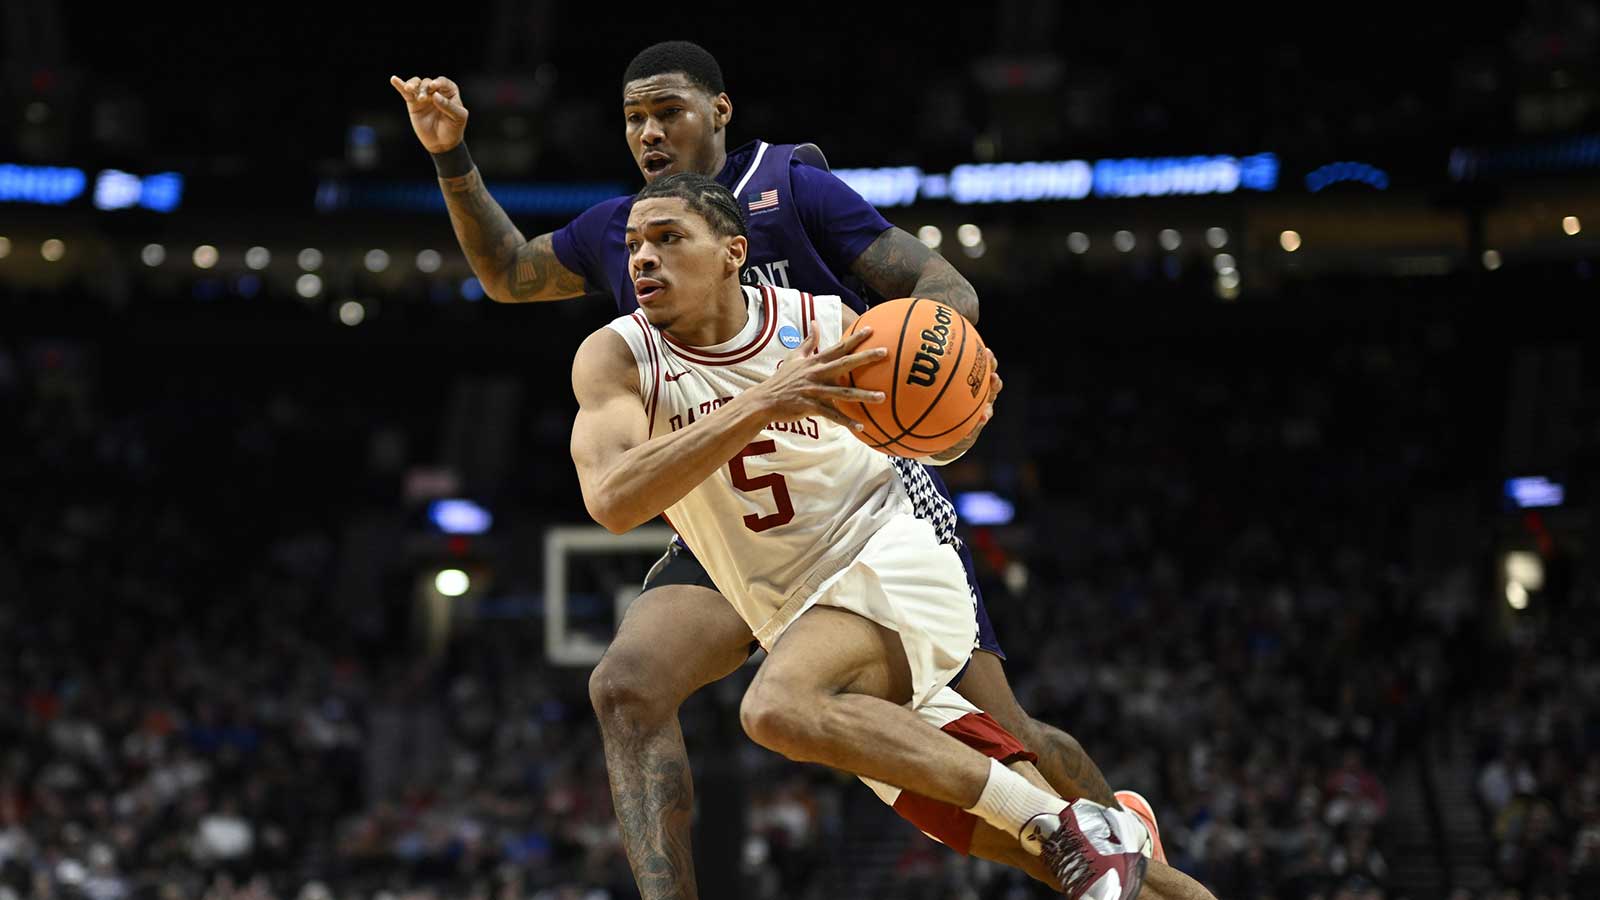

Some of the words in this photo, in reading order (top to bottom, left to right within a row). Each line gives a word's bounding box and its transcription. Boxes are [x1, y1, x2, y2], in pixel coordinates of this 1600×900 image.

[783, 335, 801, 344] NCAA
[906, 304, 953, 387] Wilson
[728, 439, 795, 533] 5
